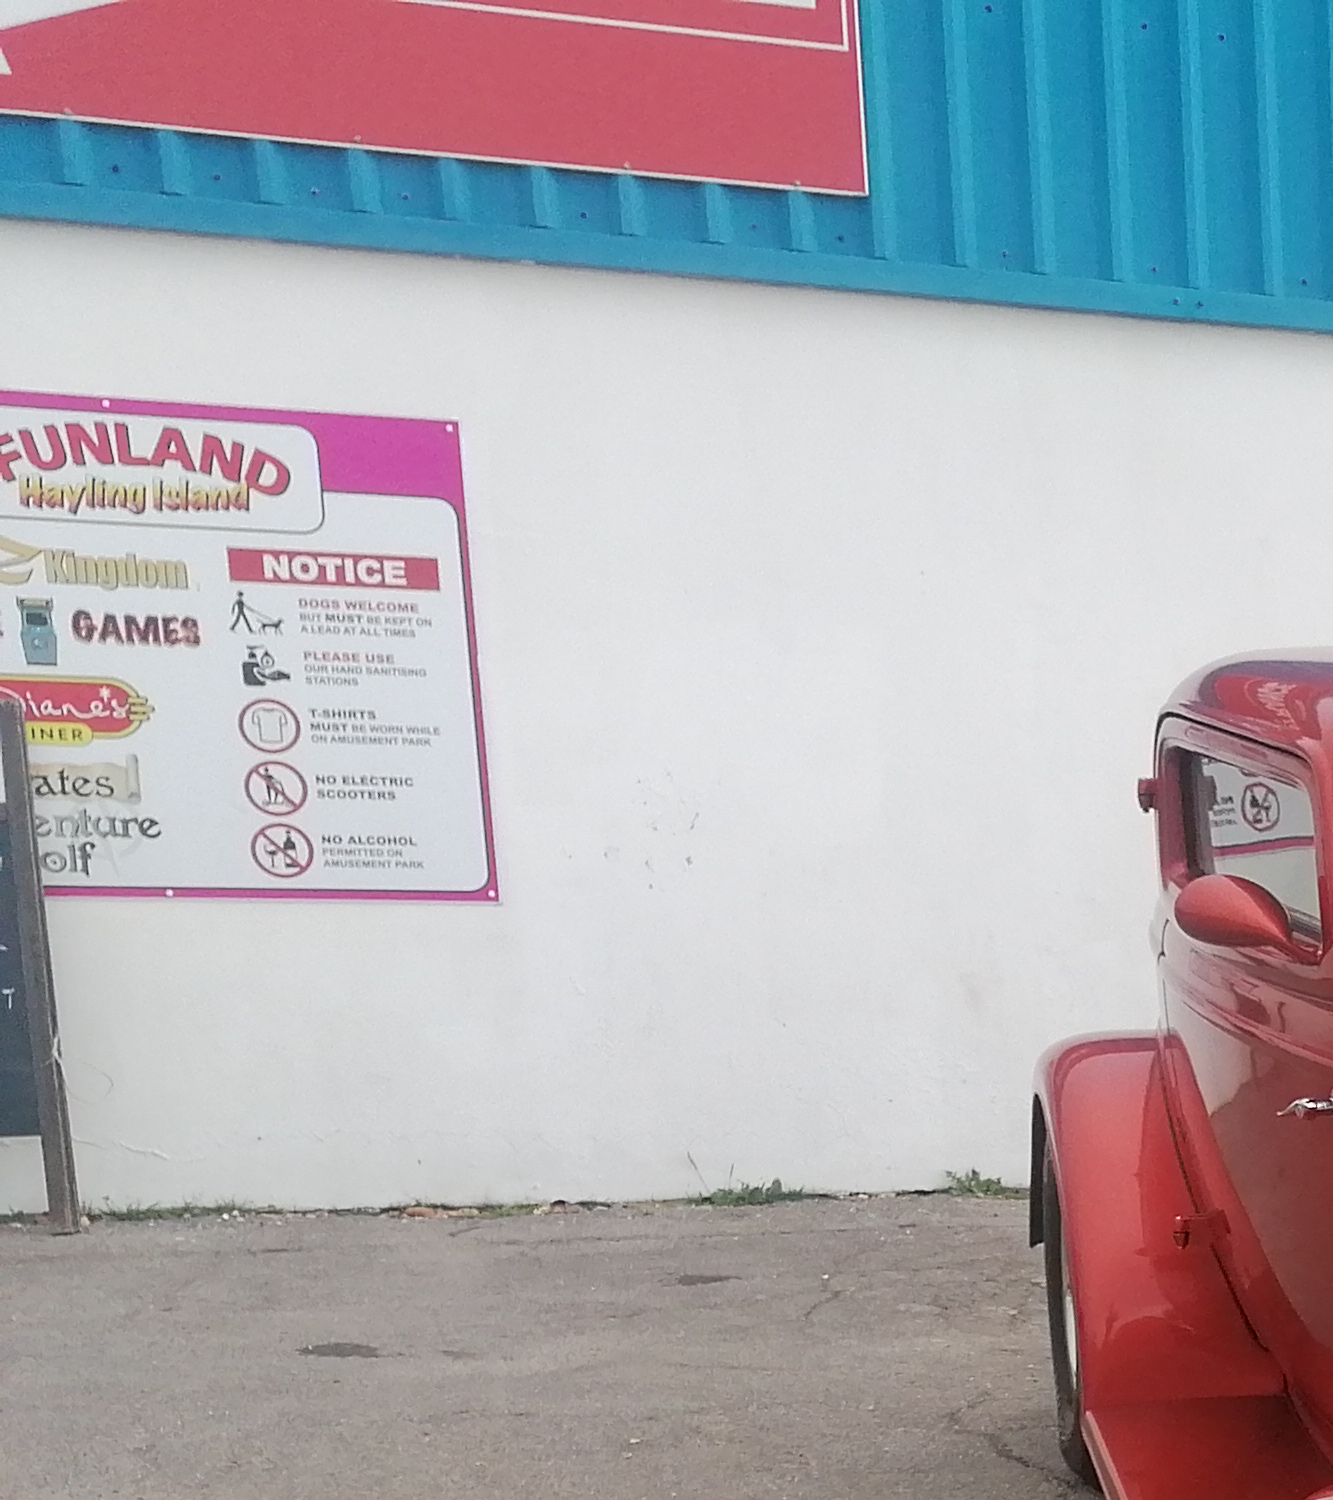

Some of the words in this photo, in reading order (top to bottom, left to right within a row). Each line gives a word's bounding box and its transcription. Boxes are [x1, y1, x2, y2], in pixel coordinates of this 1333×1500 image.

[19, 474, 147, 516] Hayling
[152, 476, 250, 513] Island
[44, 549, 189, 590] Kingdom
[262, 553, 408, 586] NOTICE
[298, 598, 341, 610] DOGS
[344, 600, 420, 614] WELCOME
[300, 613, 322, 623] BUT
[325, 613, 363, 624] MUST
[366, 616, 381, 625] BE
[384, 616, 412, 627] KEPT
[415, 618, 432, 628] ON
[72, 609, 201, 647] GAMES
[310, 625, 341, 635] LEAD
[343, 626, 357, 636] AT
[359, 627, 382, 636] ALL
[383, 628, 416, 638] TIMES
[303, 651, 361, 663] PLEASE
[365, 653, 395, 665] USE
[304, 664, 329, 674] OUR
[330, 665, 363, 675] HAND
[305, 676, 359, 687] STATIONS
[308, 708, 377, 720] T-SHIRTS
[31, 727, 83, 741] INER
[310, 722, 348, 733] MUST
[351, 724, 367, 734] BE
[369, 724, 403, 735] WORN
[406, 726, 441, 736] WHILE
[310, 734, 328, 744] ON
[329, 735, 400, 746] AMUSEMENT
[401, 736, 432, 747] PARK
[31, 767, 115, 797] ates
[315, 774, 337, 785] NO
[341, 775, 414, 787] ELECTRIC
[316, 789, 396, 800] SCOOTERS
[34, 807, 161, 839] enture
[321, 834, 343, 845] NO
[347, 835, 418, 847] ALCOHOL
[40, 841, 95, 877] olf
[322, 848, 385, 857] PERMITTED
[386, 848, 403, 857] ON
[323, 859, 393, 869] AMUSEMENT
[395, 860, 425, 870] PARK
